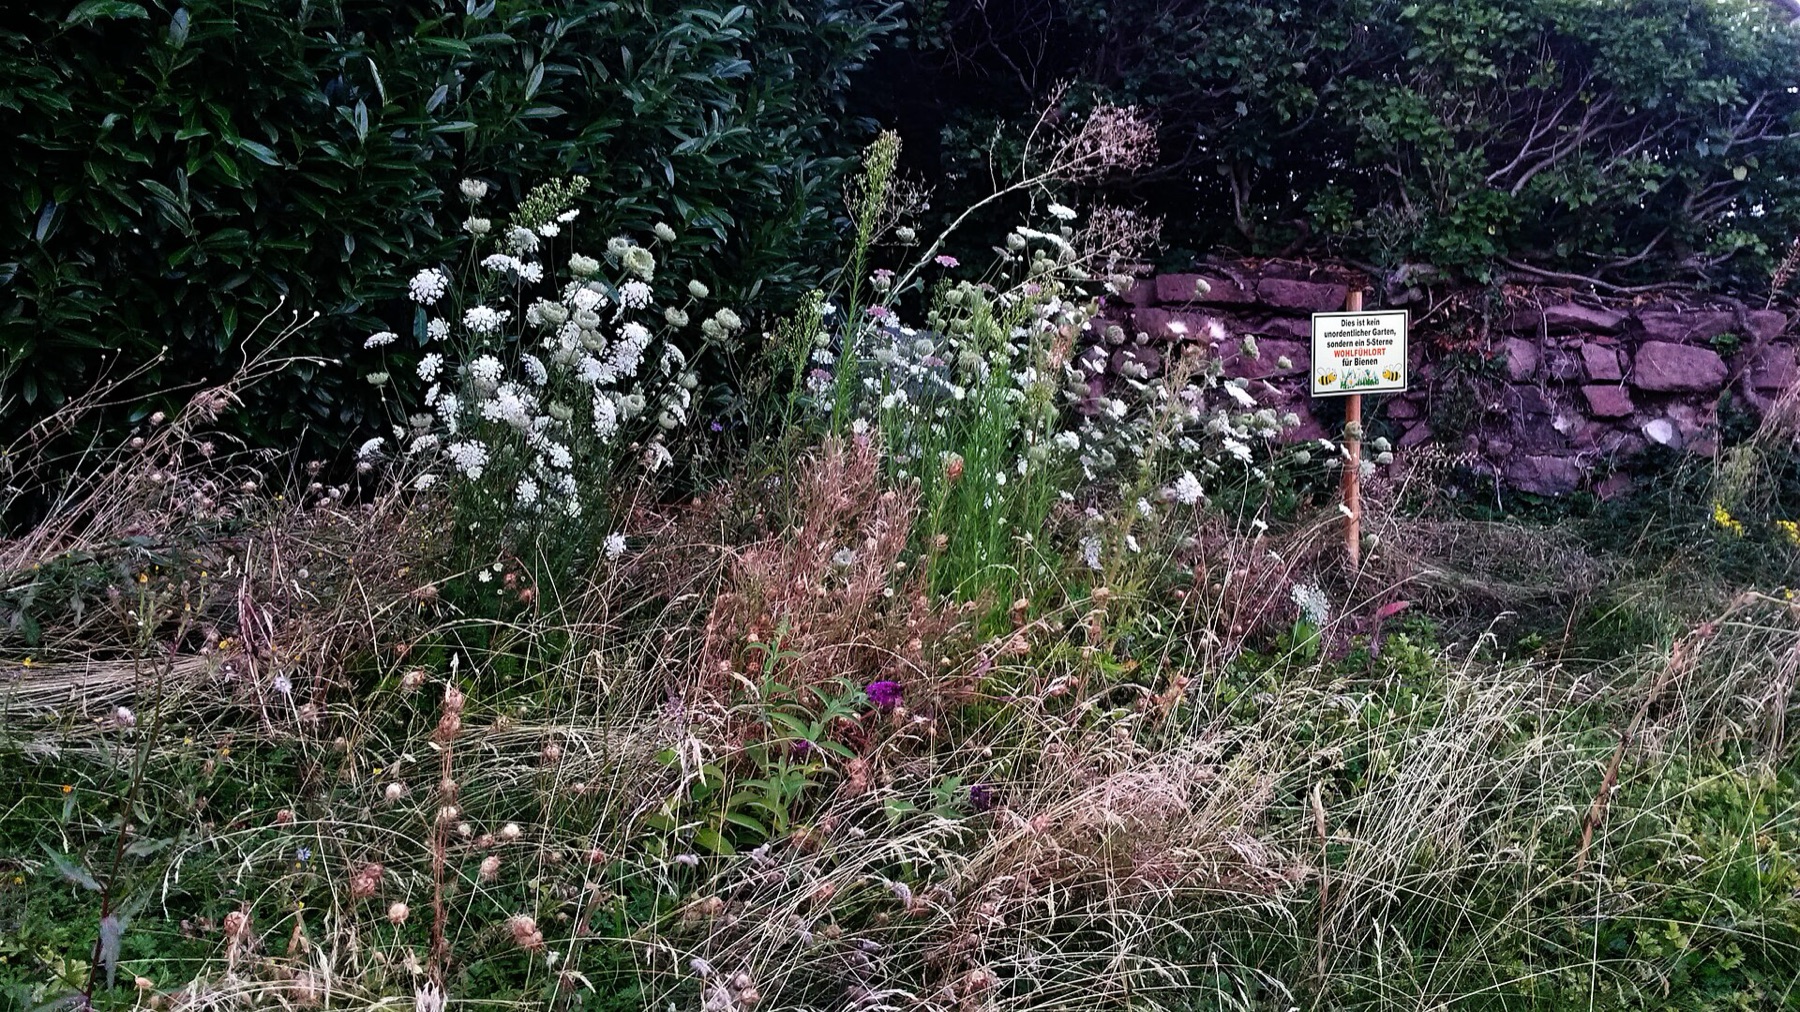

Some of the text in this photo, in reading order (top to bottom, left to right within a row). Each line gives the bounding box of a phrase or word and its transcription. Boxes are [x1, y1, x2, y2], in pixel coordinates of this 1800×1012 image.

[1341, 318, 1380, 327] Dies ist kein
[1324, 328, 1396, 338] unordentlicher Garten,
[1327, 338, 1393, 348] sondern ein 5-Sterne
[1334, 347, 1386, 358] WOHLFÜHLORT
[1342, 357, 1378, 366] für Bienen
